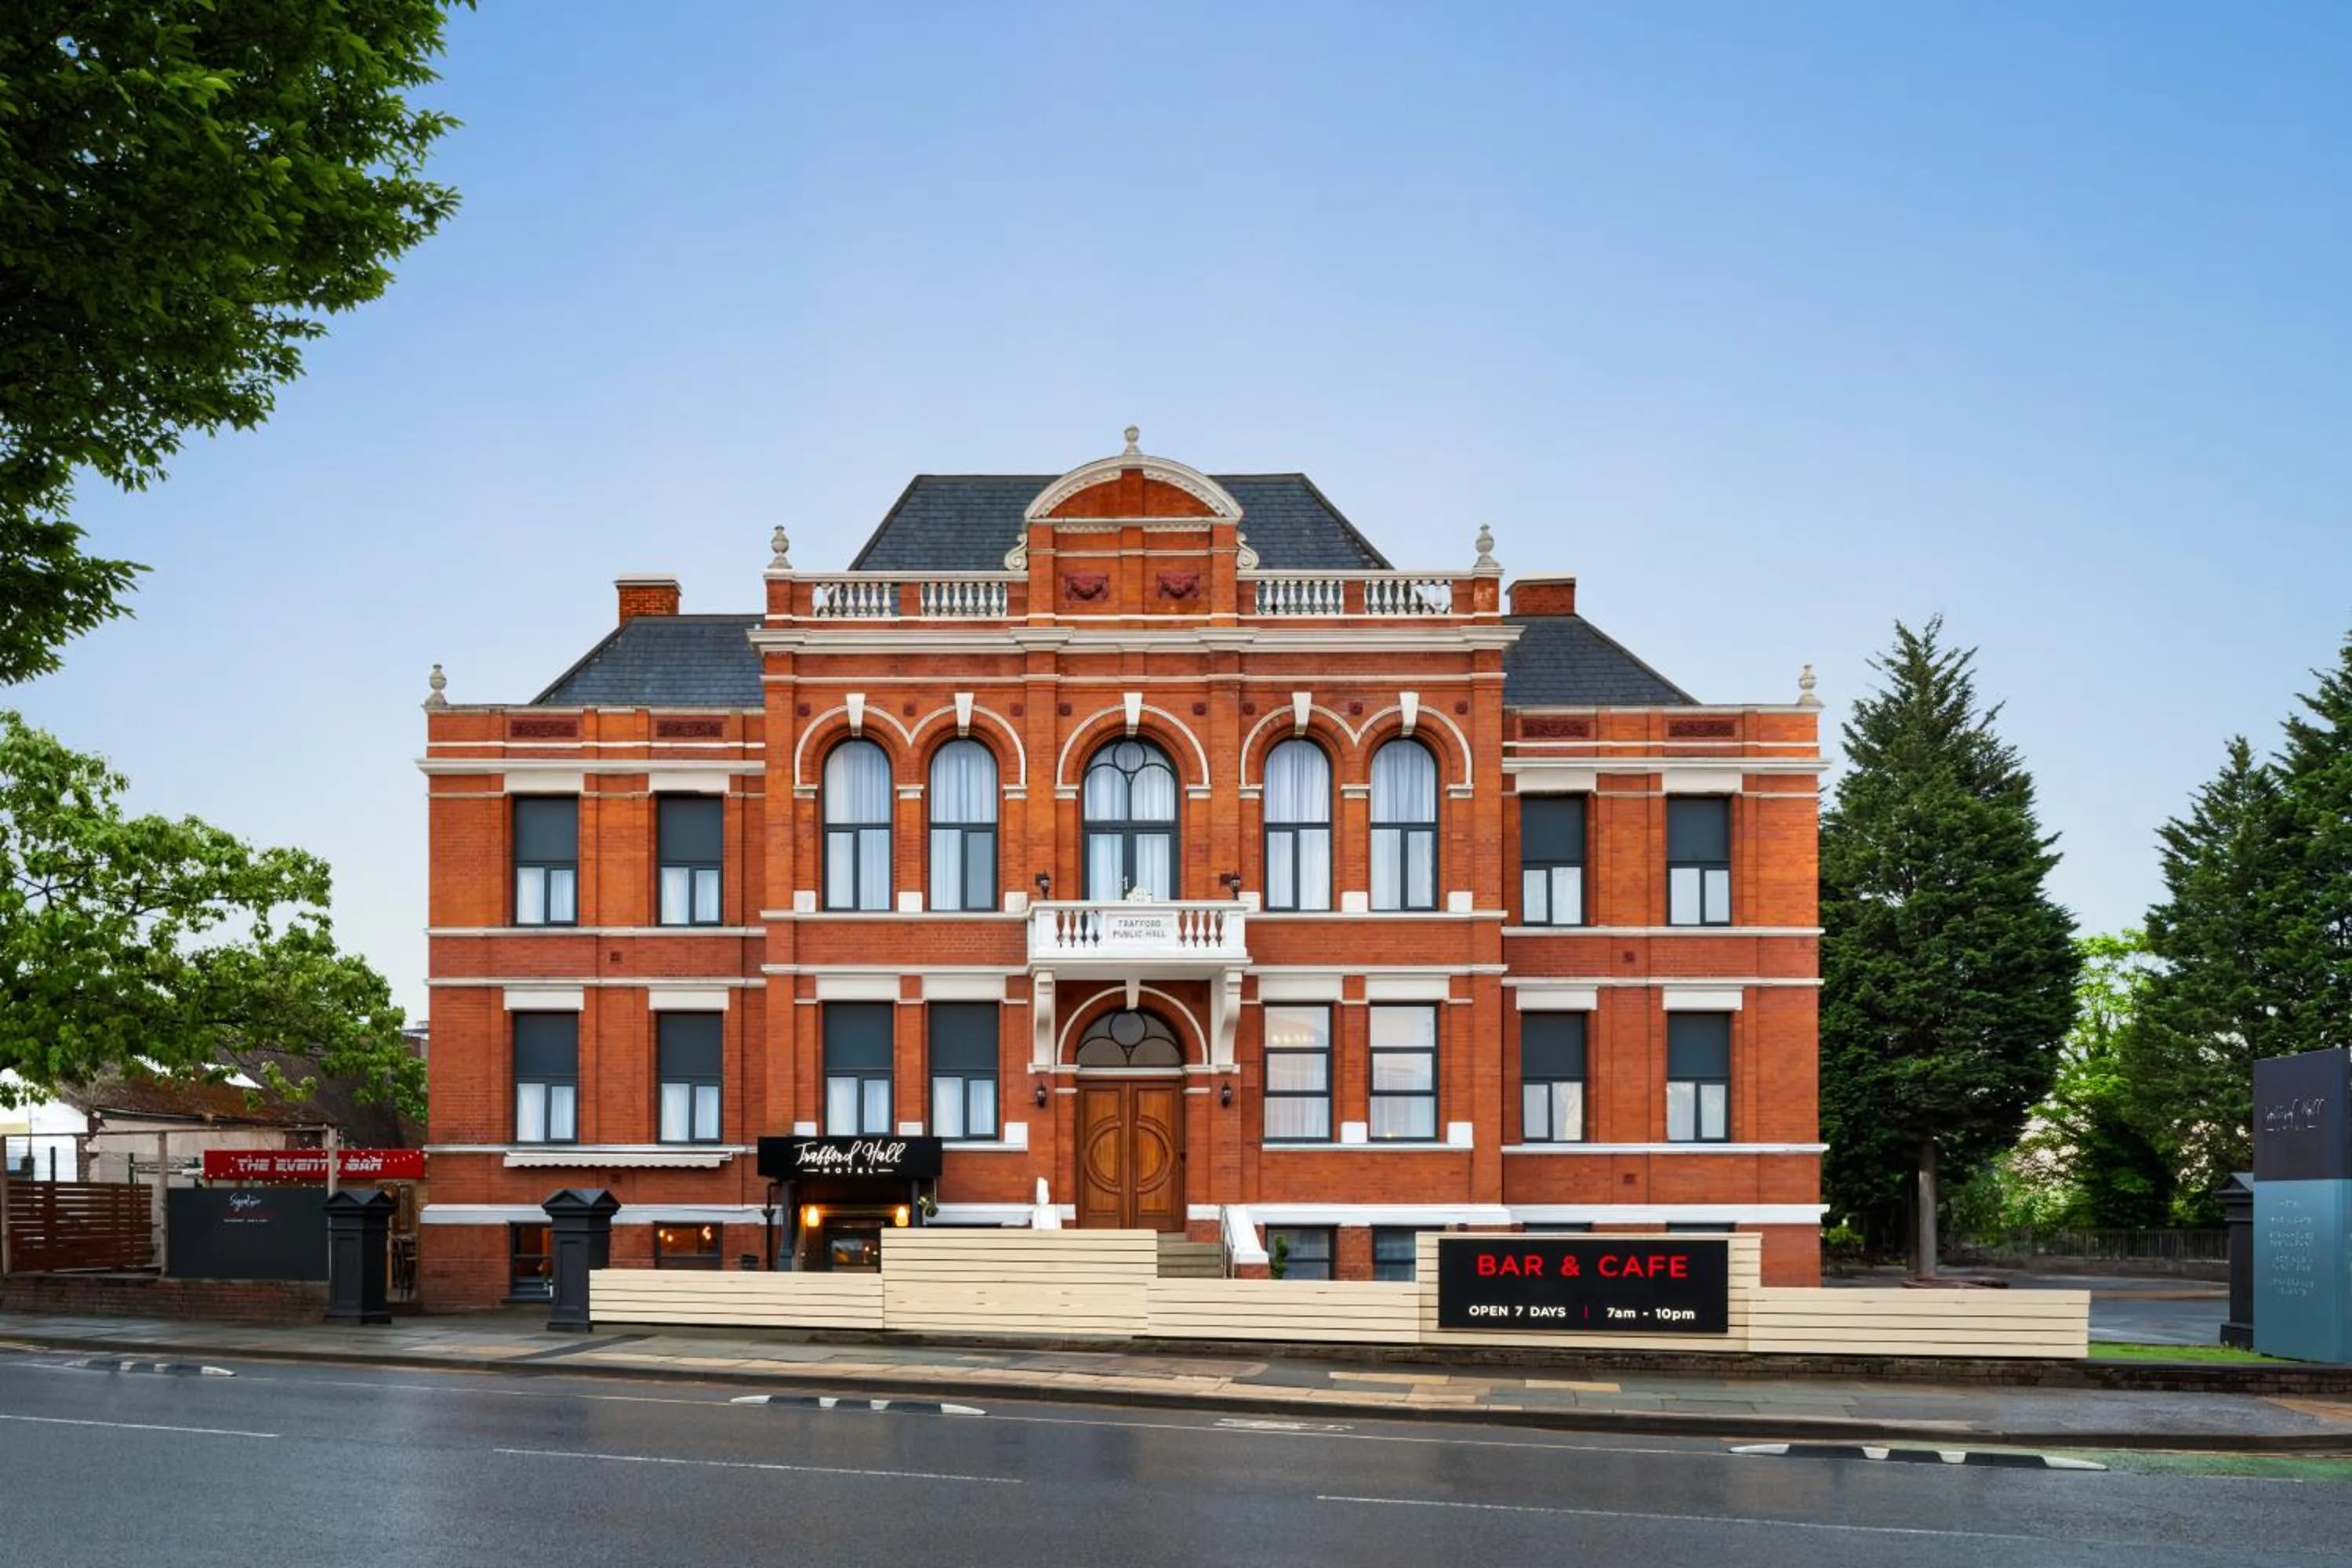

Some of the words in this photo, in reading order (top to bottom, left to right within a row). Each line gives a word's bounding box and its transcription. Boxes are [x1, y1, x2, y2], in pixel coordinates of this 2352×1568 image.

[1118, 920, 1161, 928] TRAFFORD
[793, 1140, 862, 1166] Trafford
[862, 1139, 906, 1166] Hall
[238, 1158, 270, 1172] THE
[345, 1158, 383, 1171] BAR
[1477, 1254, 1544, 1277] BAR
[1559, 1254, 1581, 1277] &
[1596, 1254, 1690, 1279] CAFE
[1468, 1305, 1508, 1317] OPEN
[1515, 1305, 1524, 1317] 7
[1530, 1306, 1566, 1319] DAYS
[1606, 1307, 1636, 1319] 7am
[1655, 1308, 1696, 1321] 10pm
